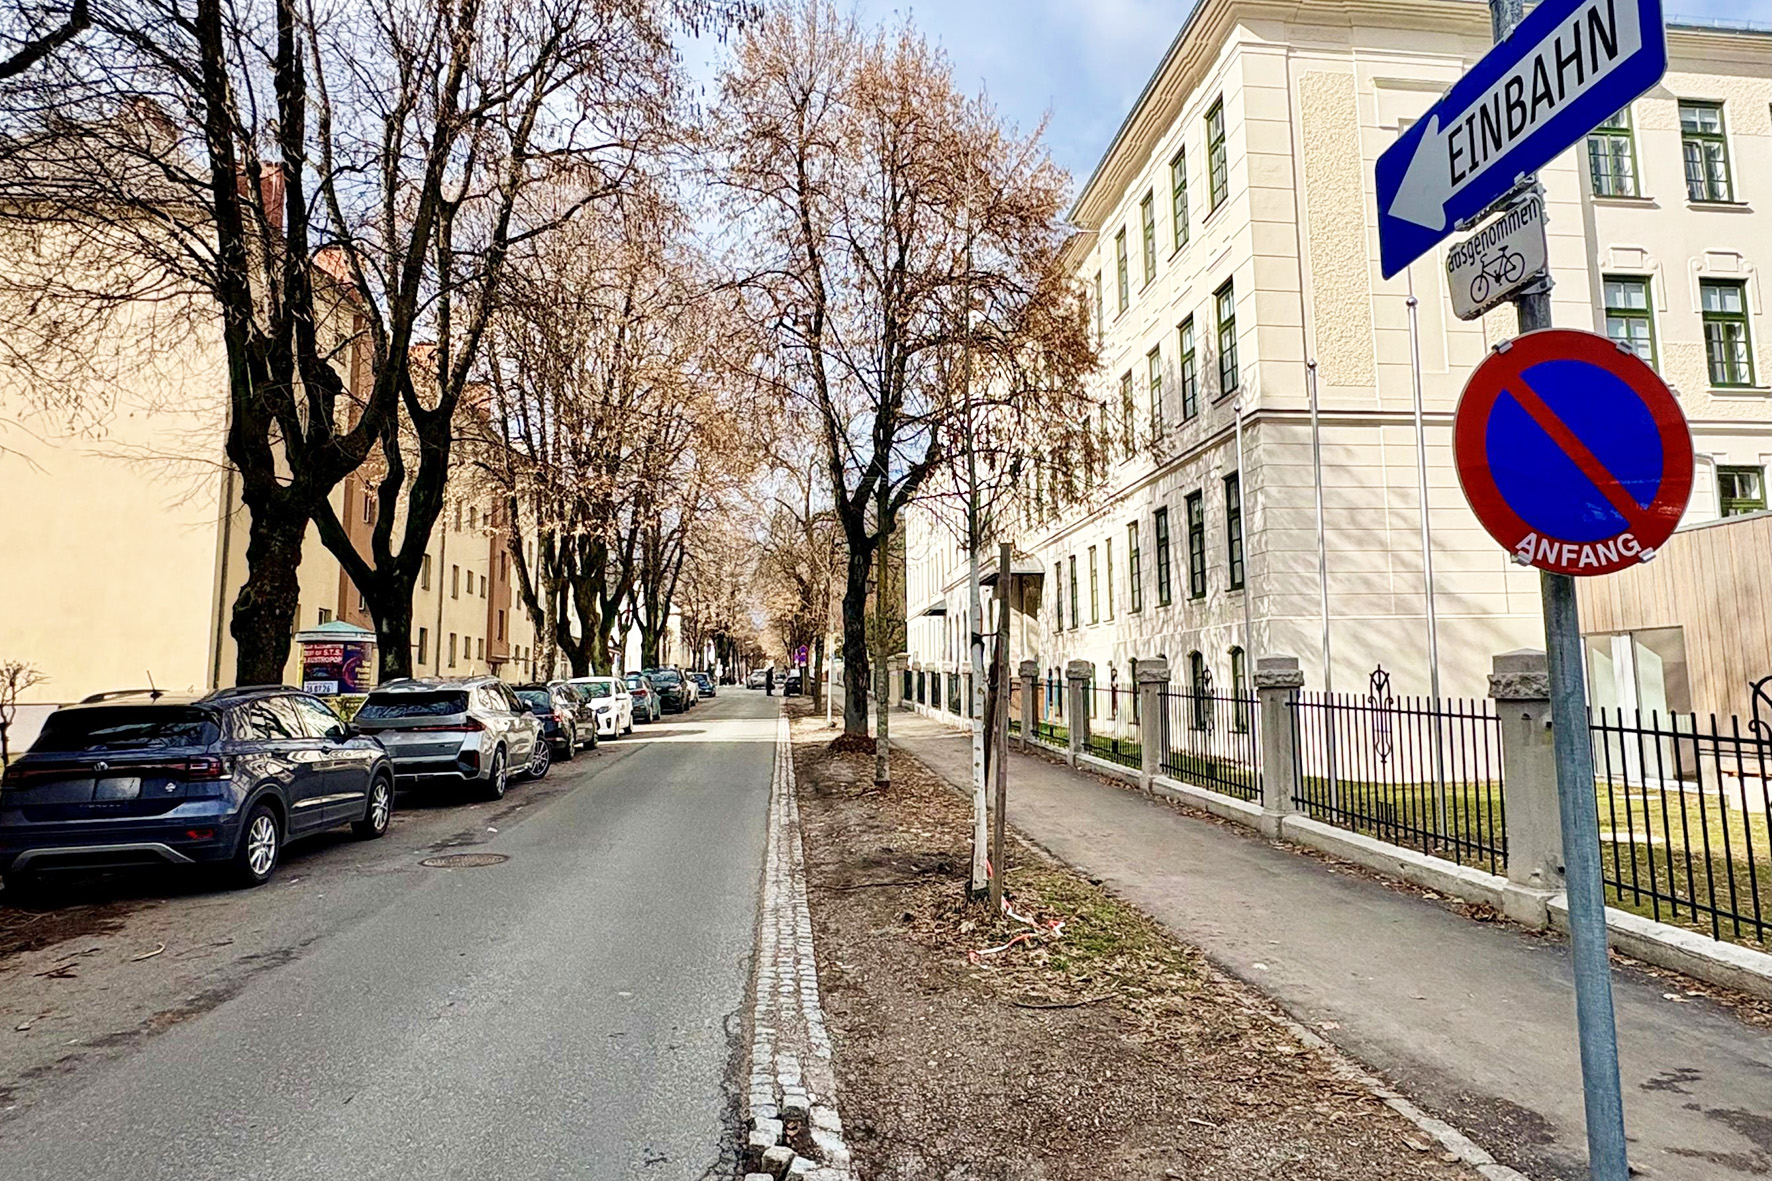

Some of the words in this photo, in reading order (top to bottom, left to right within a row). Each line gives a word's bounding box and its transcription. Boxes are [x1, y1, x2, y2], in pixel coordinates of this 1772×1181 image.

[1447, 0, 1618, 187] EINBAHN
[1448, 198, 1537, 273] ausgenommen
[1515, 532, 1642, 568] ANFANG
